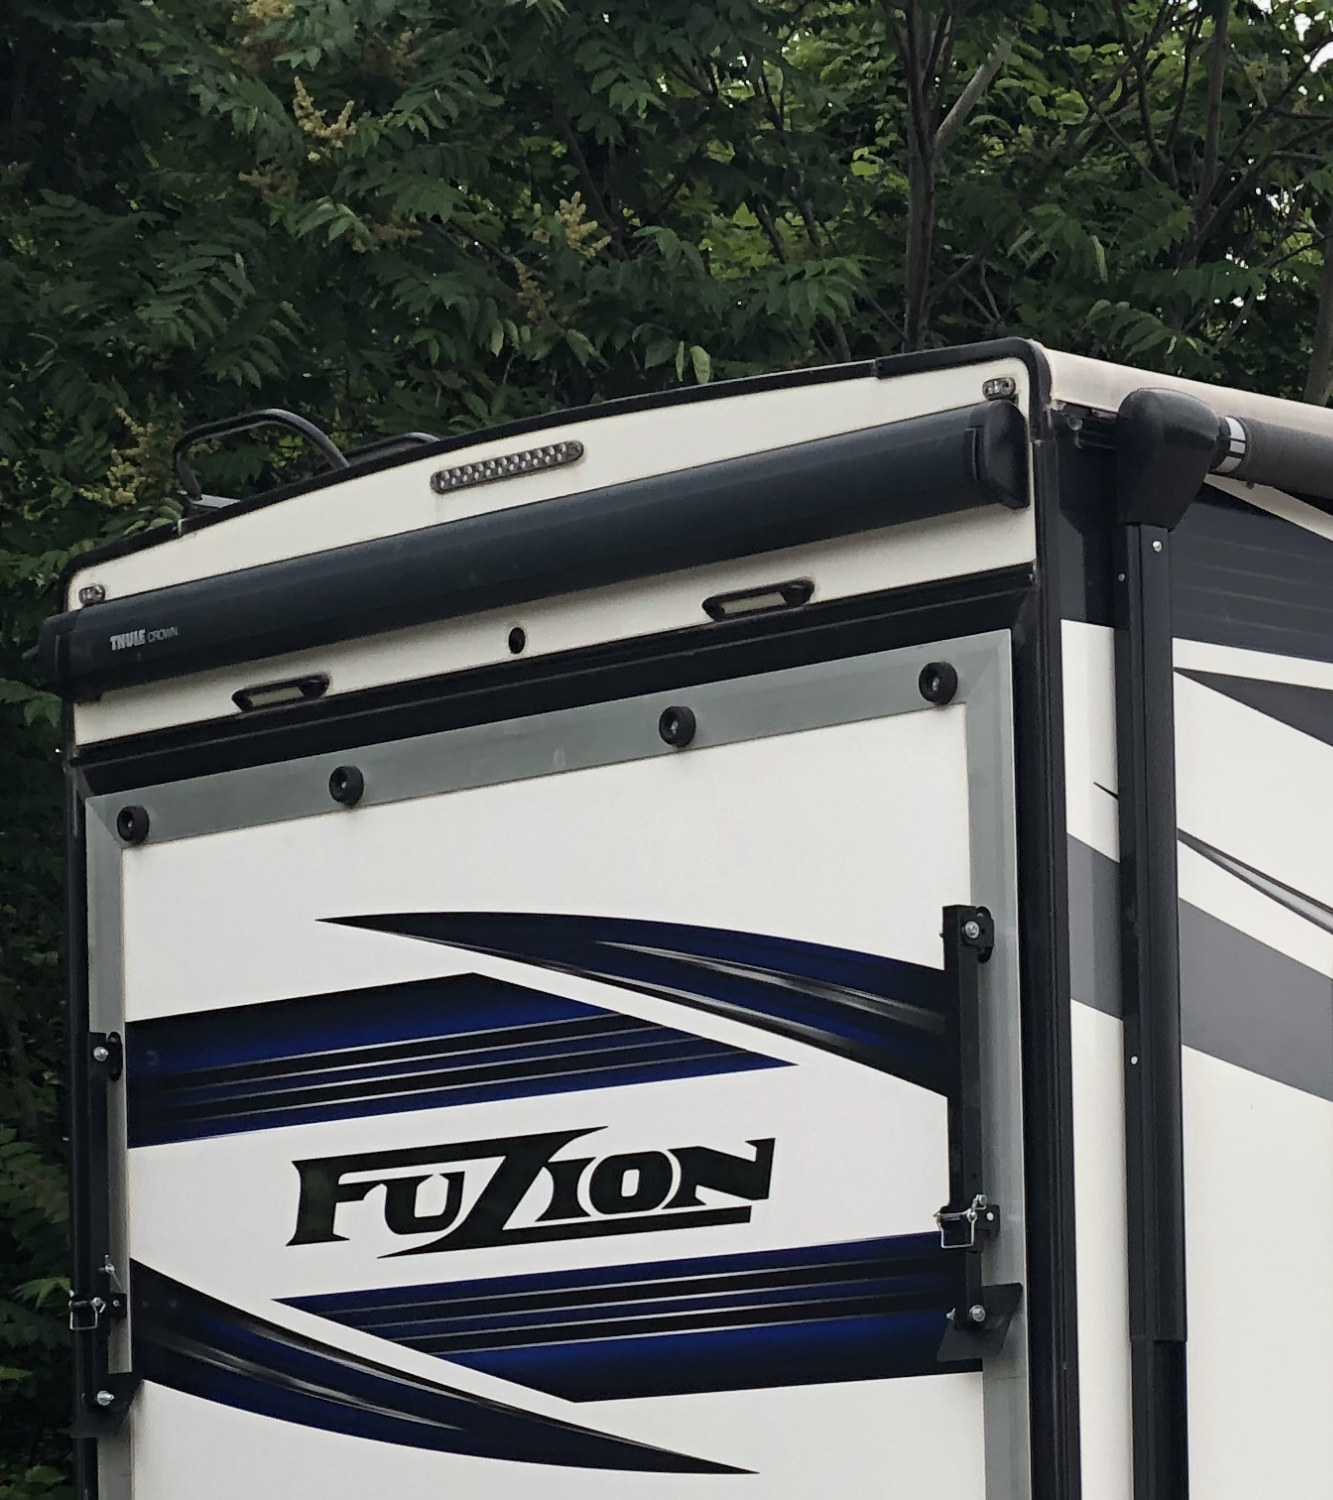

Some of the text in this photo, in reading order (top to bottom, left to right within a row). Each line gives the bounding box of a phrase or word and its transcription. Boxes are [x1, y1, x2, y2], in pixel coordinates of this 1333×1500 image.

[110, 627, 179, 651] THULE CROWN
[286, 1126, 776, 1259] FUZION
